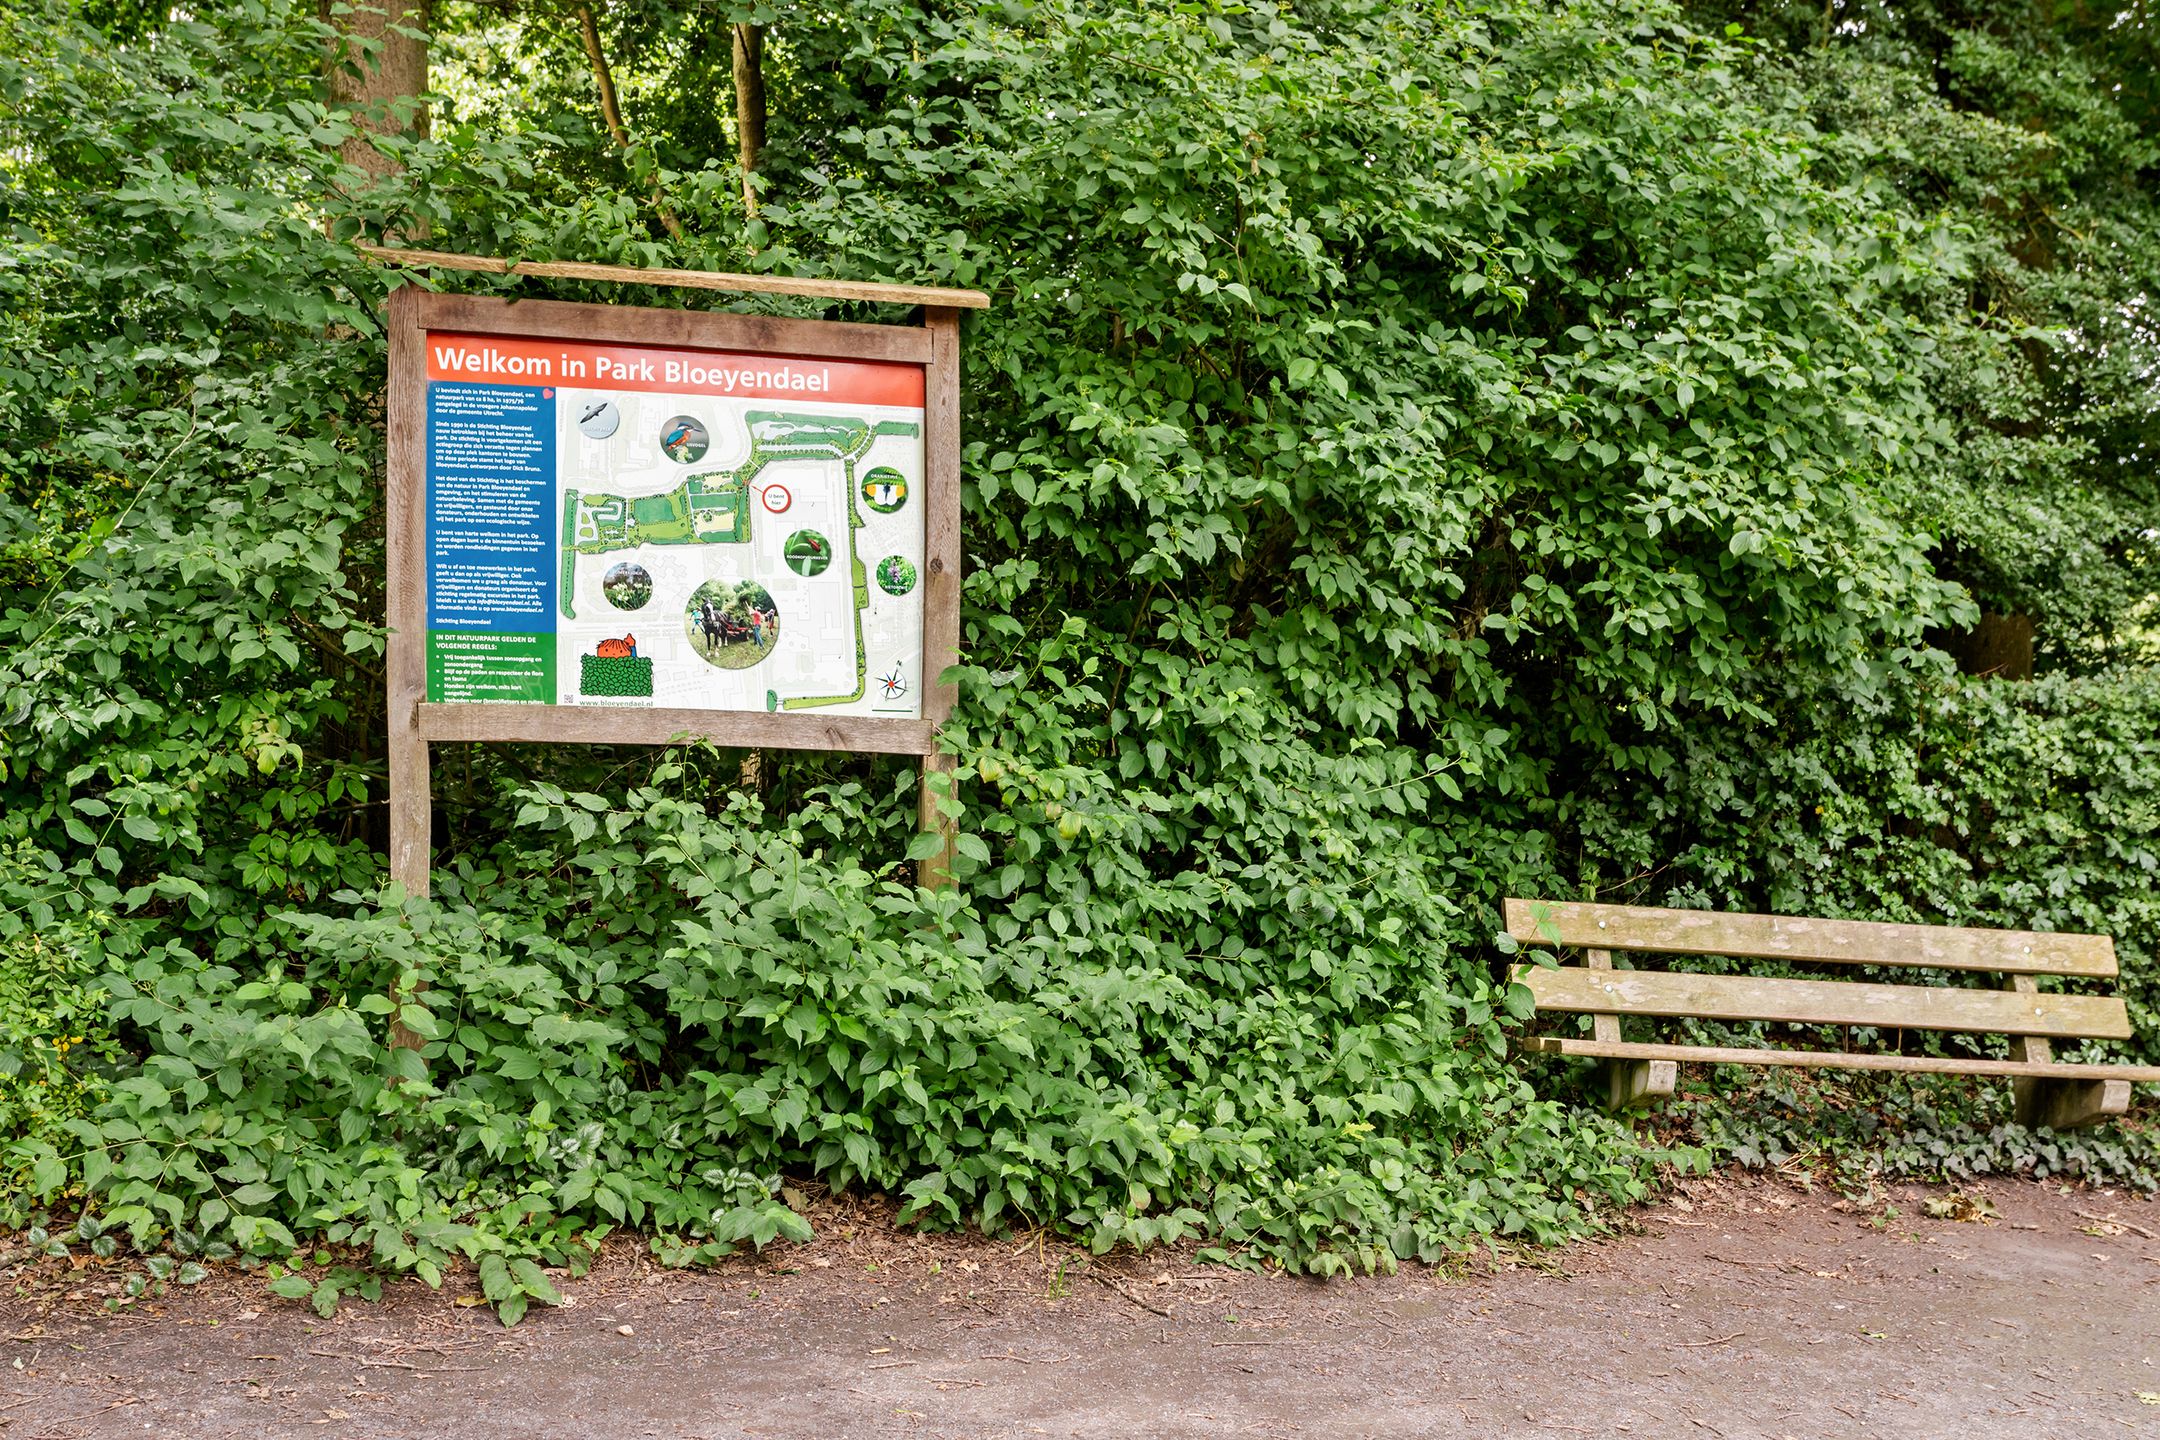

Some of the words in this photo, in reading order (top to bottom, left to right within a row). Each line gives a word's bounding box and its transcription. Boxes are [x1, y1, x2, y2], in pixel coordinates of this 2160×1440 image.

[434, 346, 550, 376] Welkom
[561, 354, 586, 378] in
[596, 357, 656, 382] Park
[664, 360, 828, 392] Bloeyendael
